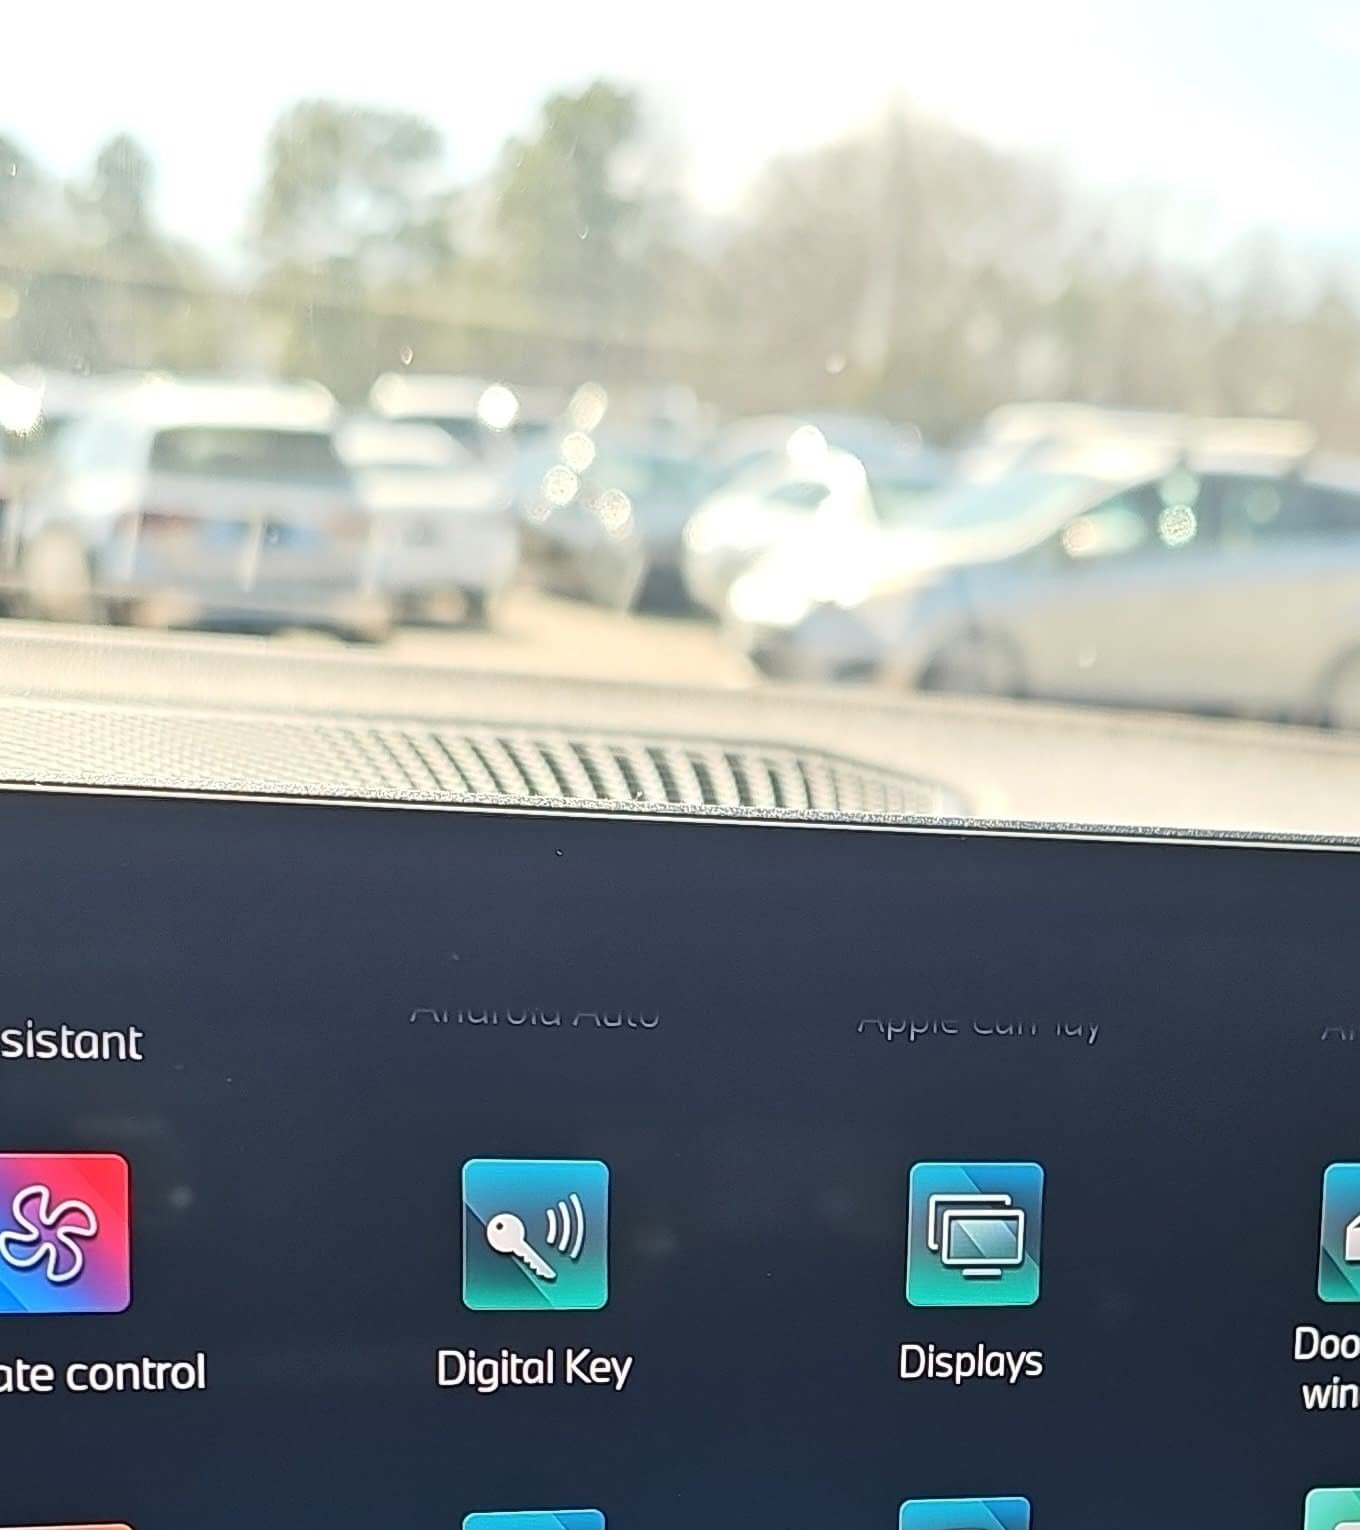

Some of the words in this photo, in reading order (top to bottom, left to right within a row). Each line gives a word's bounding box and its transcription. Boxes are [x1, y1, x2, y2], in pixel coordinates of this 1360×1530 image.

[65, 1351, 207, 1392] control
[437, 1348, 555, 1394] Digital
[565, 1347, 634, 1392] Key
[899, 1342, 1044, 1386] Displays
